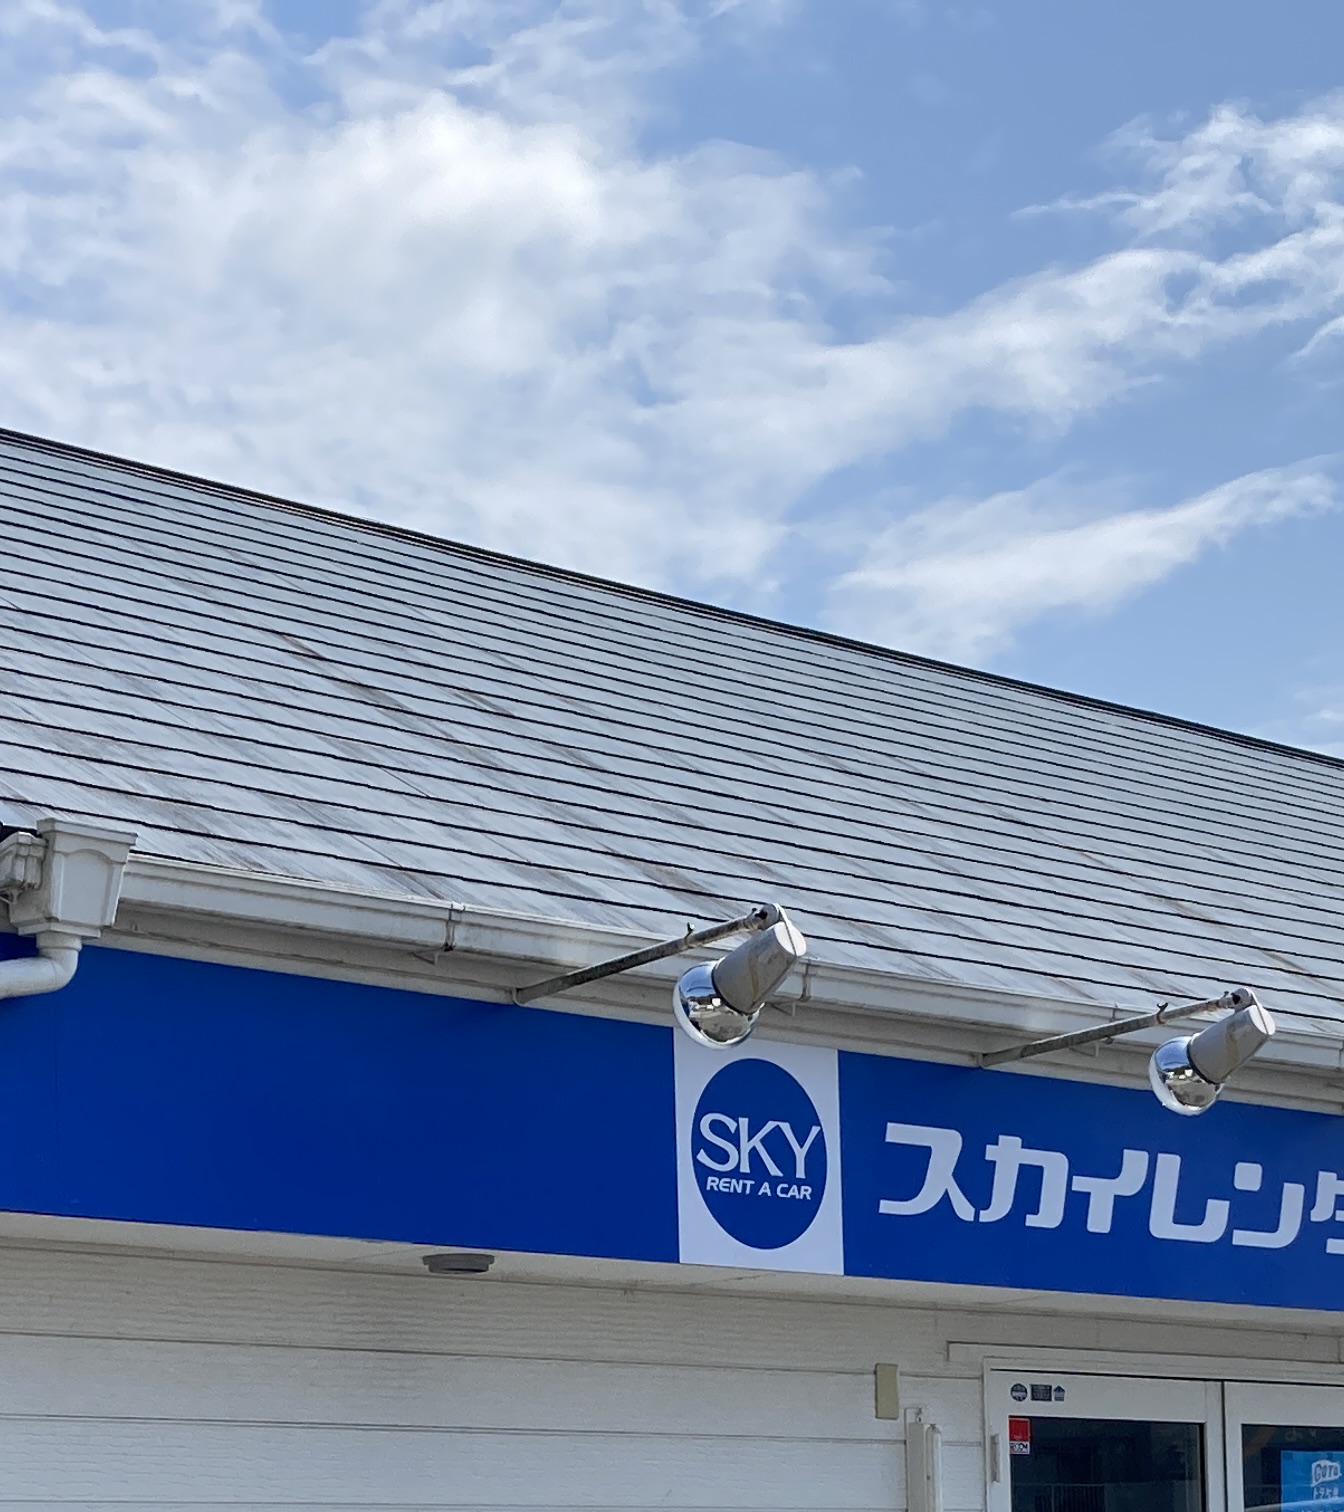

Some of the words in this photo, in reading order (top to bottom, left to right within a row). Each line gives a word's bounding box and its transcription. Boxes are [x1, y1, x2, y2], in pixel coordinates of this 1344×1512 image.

[696, 1112, 821, 1179] SKY
[706, 1176, 755, 1195] RENT
[757, 1181, 772, 1197] A
[776, 1183, 813, 1200] CAR
